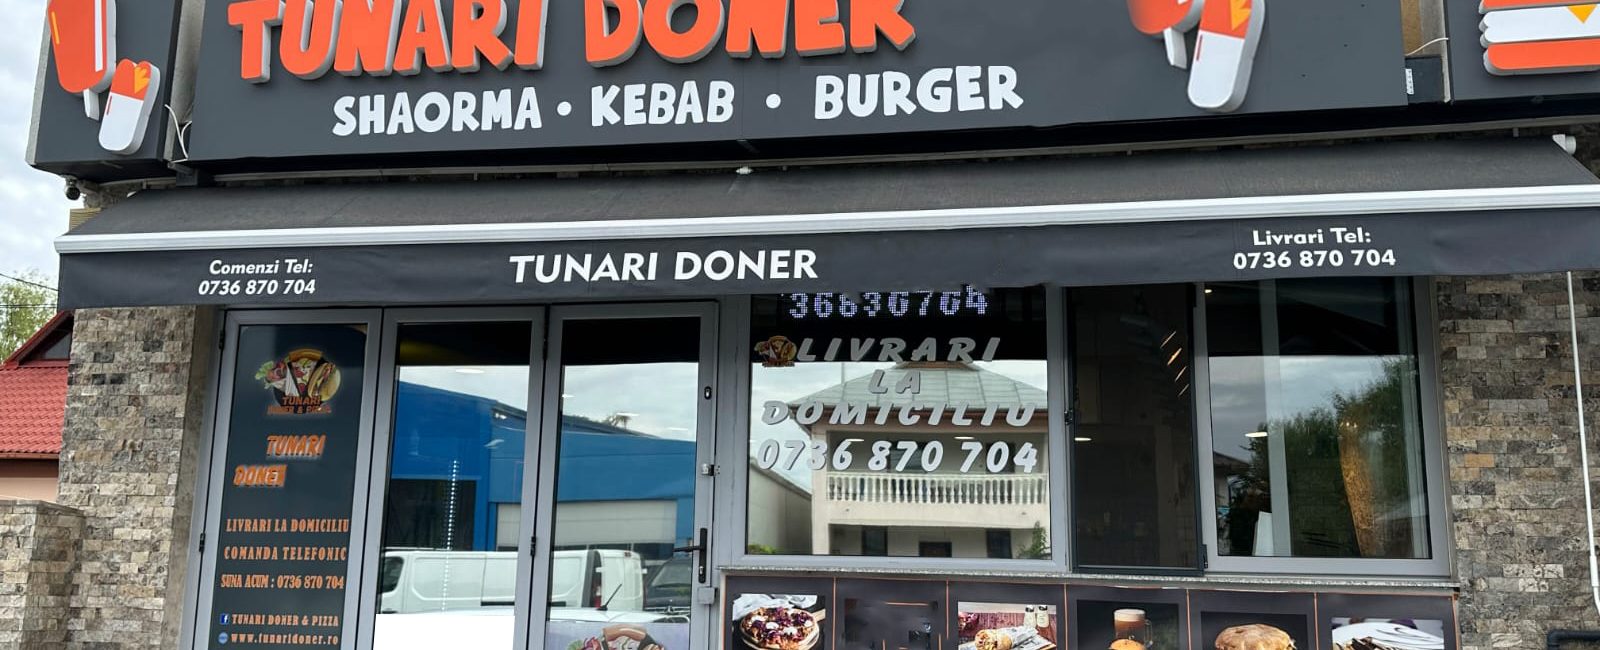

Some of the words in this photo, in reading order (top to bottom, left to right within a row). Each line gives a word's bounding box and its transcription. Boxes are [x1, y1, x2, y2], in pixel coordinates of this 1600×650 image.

[227, 0, 549, 84] TUNARI
[585, 0, 917, 68] DONER
[332, 86, 542, 136] SHAORMA
[590, 80, 735, 127] KEBAB
[814, 65, 1024, 120] BURGER
[1252, 228, 1324, 246] Livrari
[1329, 226, 1372, 244] Tel:
[209, 259, 280, 275] Comenzi
[284, 258, 314, 274] Tel:
[509, 252, 658, 283] TUNARI
[673, 249, 819, 281] DONER
[1233, 251, 1292, 270] 0736
[1299, 249, 1344, 268] 870
[1350, 248, 1397, 267] 704
[198, 280, 241, 295] 0736
[245, 279, 279, 295] 870
[282, 278, 316, 295] 704
[796, 337, 1001, 363] LIVRARI
[868, 369, 921, 394] LA
[761, 400, 1036, 427] DOMICILIU
[266, 435, 327, 457] TUNARI
[757, 438, 853, 471] 0736
[867, 440, 944, 472] 870
[959, 440, 1038, 474] 704
[226, 518, 272, 533] LIVRARI
[274, 519, 287, 533] LA
[290, 519, 350, 533] DOMICILIU
[223, 546, 278, 561] COMANDA
[282, 547, 347, 561] TELEFONIC
[220, 574, 243, 588] SUNA
[244, 574, 270, 588] ACUM
[276, 575, 302, 589] 0736
[303, 576, 323, 589] 870
[325, 575, 345, 589] 704
[231, 613, 265, 625] TUNARI
[267, 614, 299, 626] DONER
[311, 615, 339, 627] PIZZA
